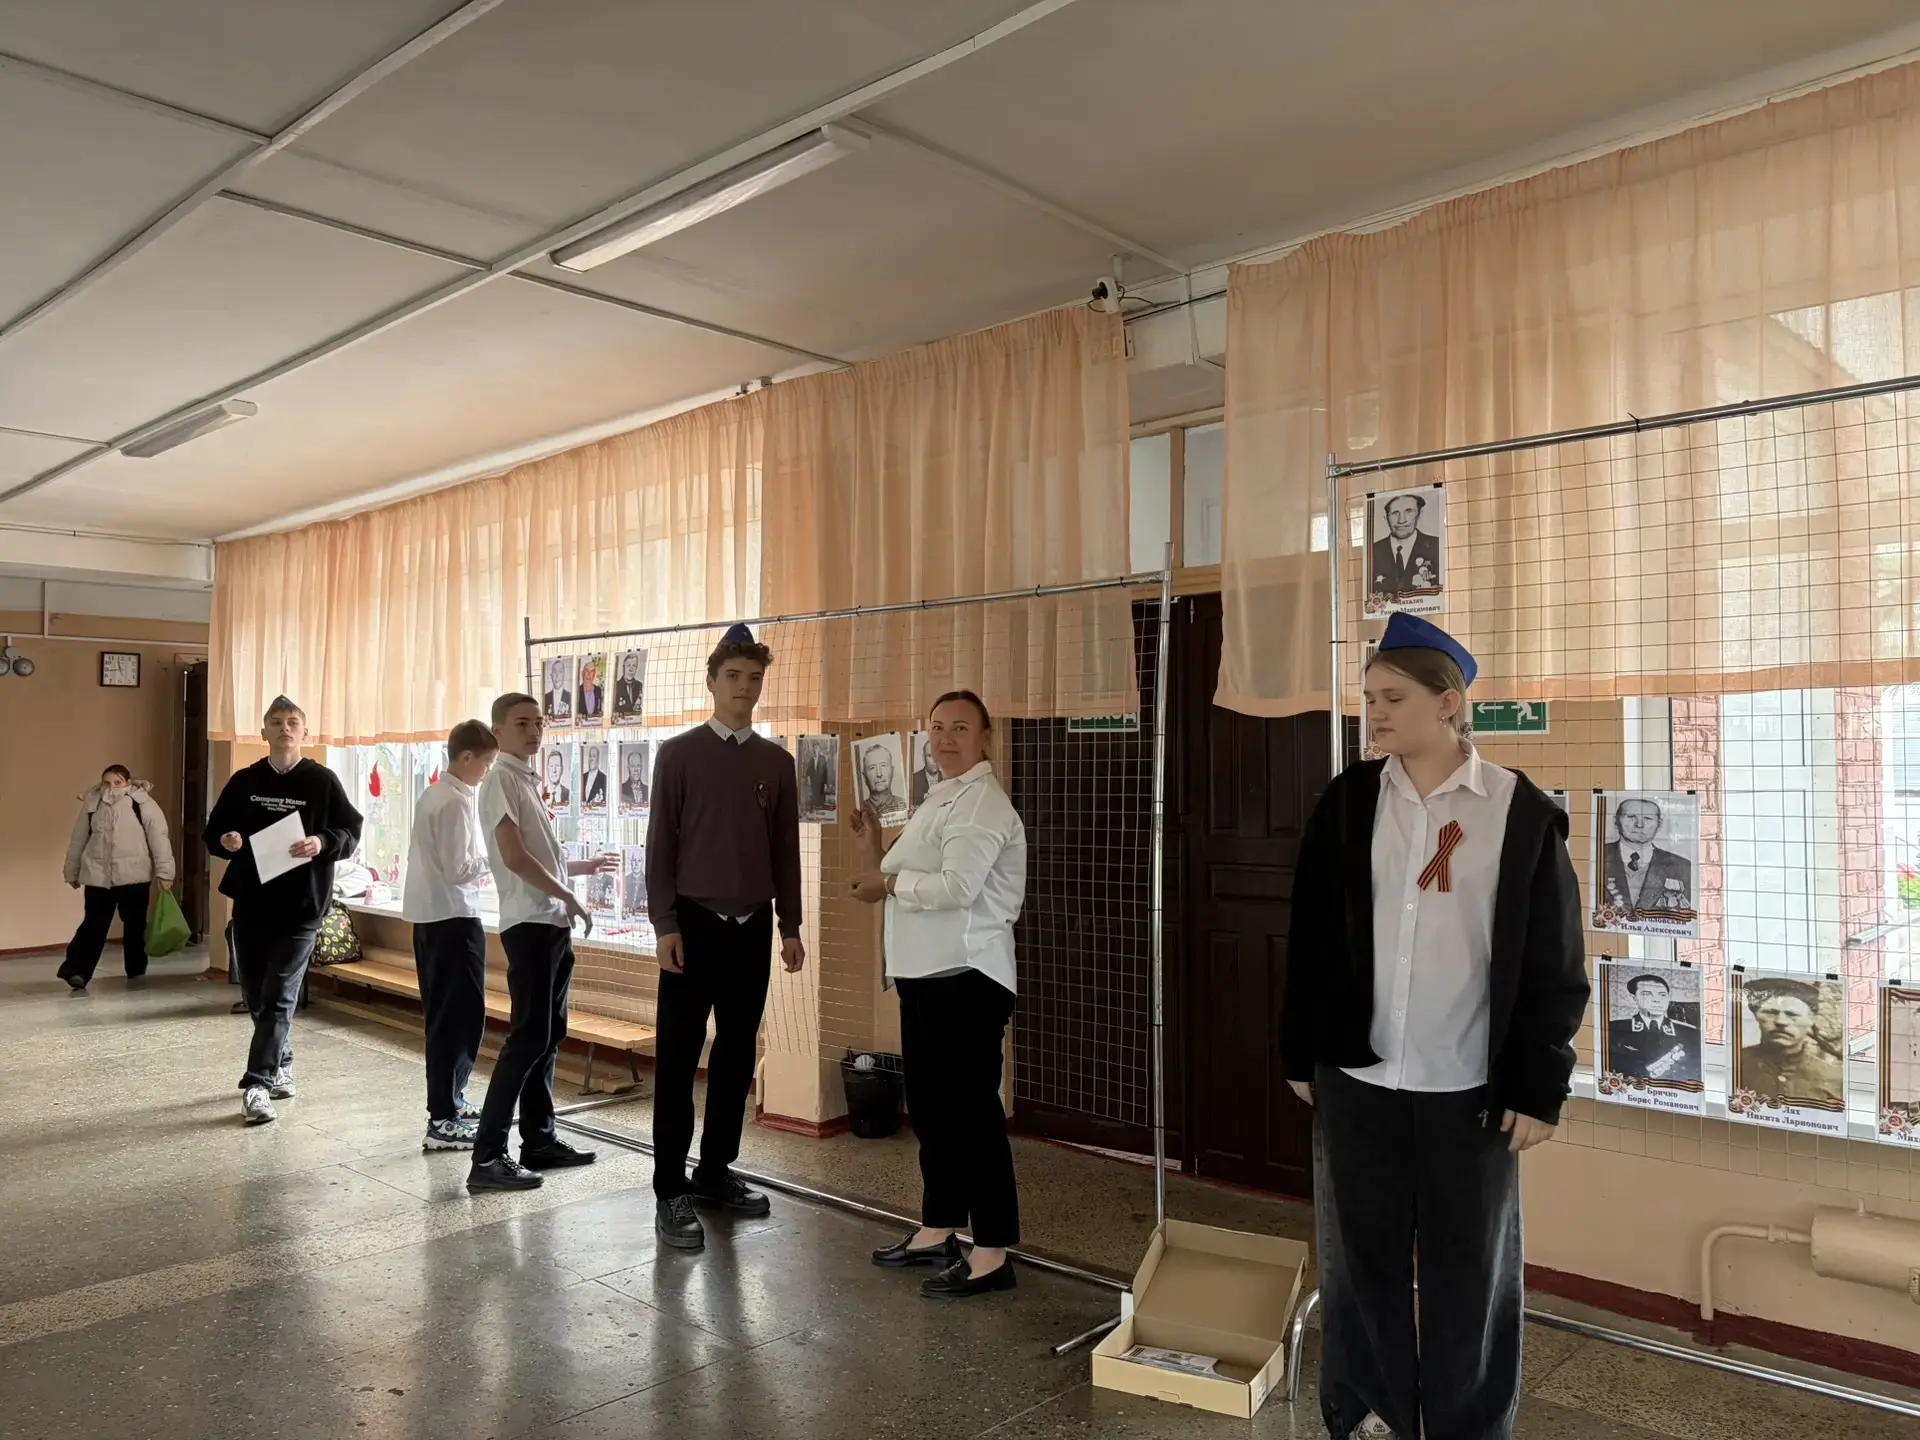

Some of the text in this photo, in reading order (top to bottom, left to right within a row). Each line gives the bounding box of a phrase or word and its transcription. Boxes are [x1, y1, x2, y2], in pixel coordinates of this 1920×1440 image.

[250, 795, 307, 806] Company Name
[1620, 922, 1692, 936] Илья Алексеевич
[1647, 1087, 1678, 1098] Бричко
[1627, 1094, 1699, 1111] Борис Романович
[1782, 1107, 1800, 1115] Лях
[1746, 1111, 1839, 1131] Никита Ларионович
